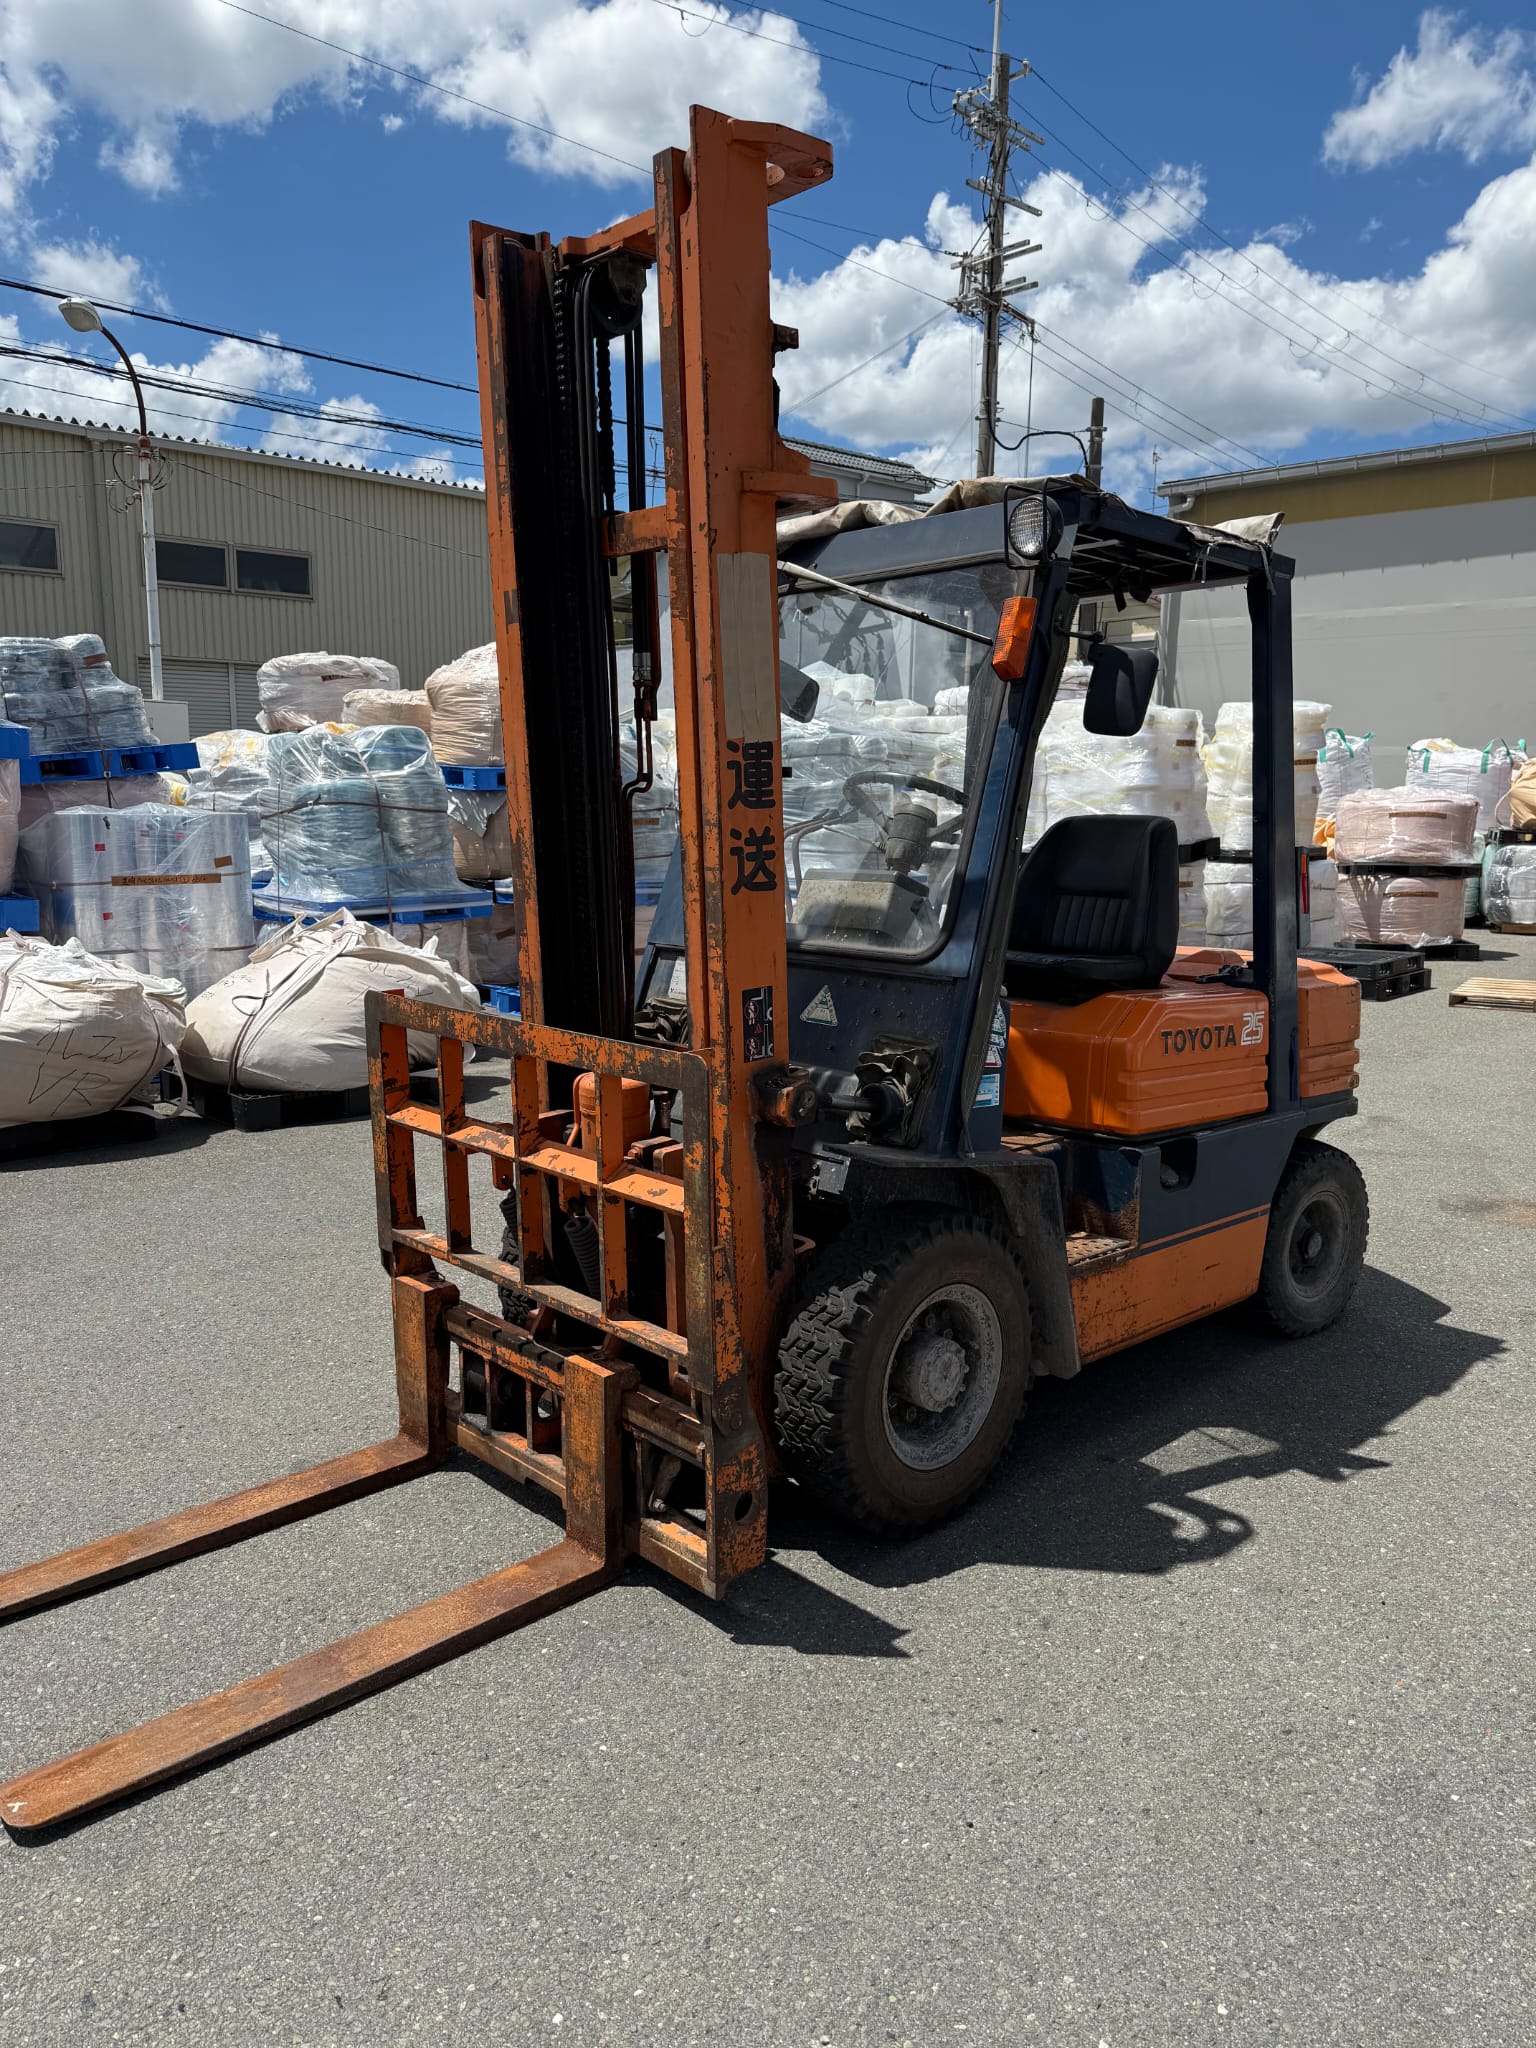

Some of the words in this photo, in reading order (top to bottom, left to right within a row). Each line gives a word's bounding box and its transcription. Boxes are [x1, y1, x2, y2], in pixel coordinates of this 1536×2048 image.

[727, 740, 777, 895] 運送
[1161, 1024, 1237, 1055] TOYOTA
[1240, 1011, 1265, 1046] 25
